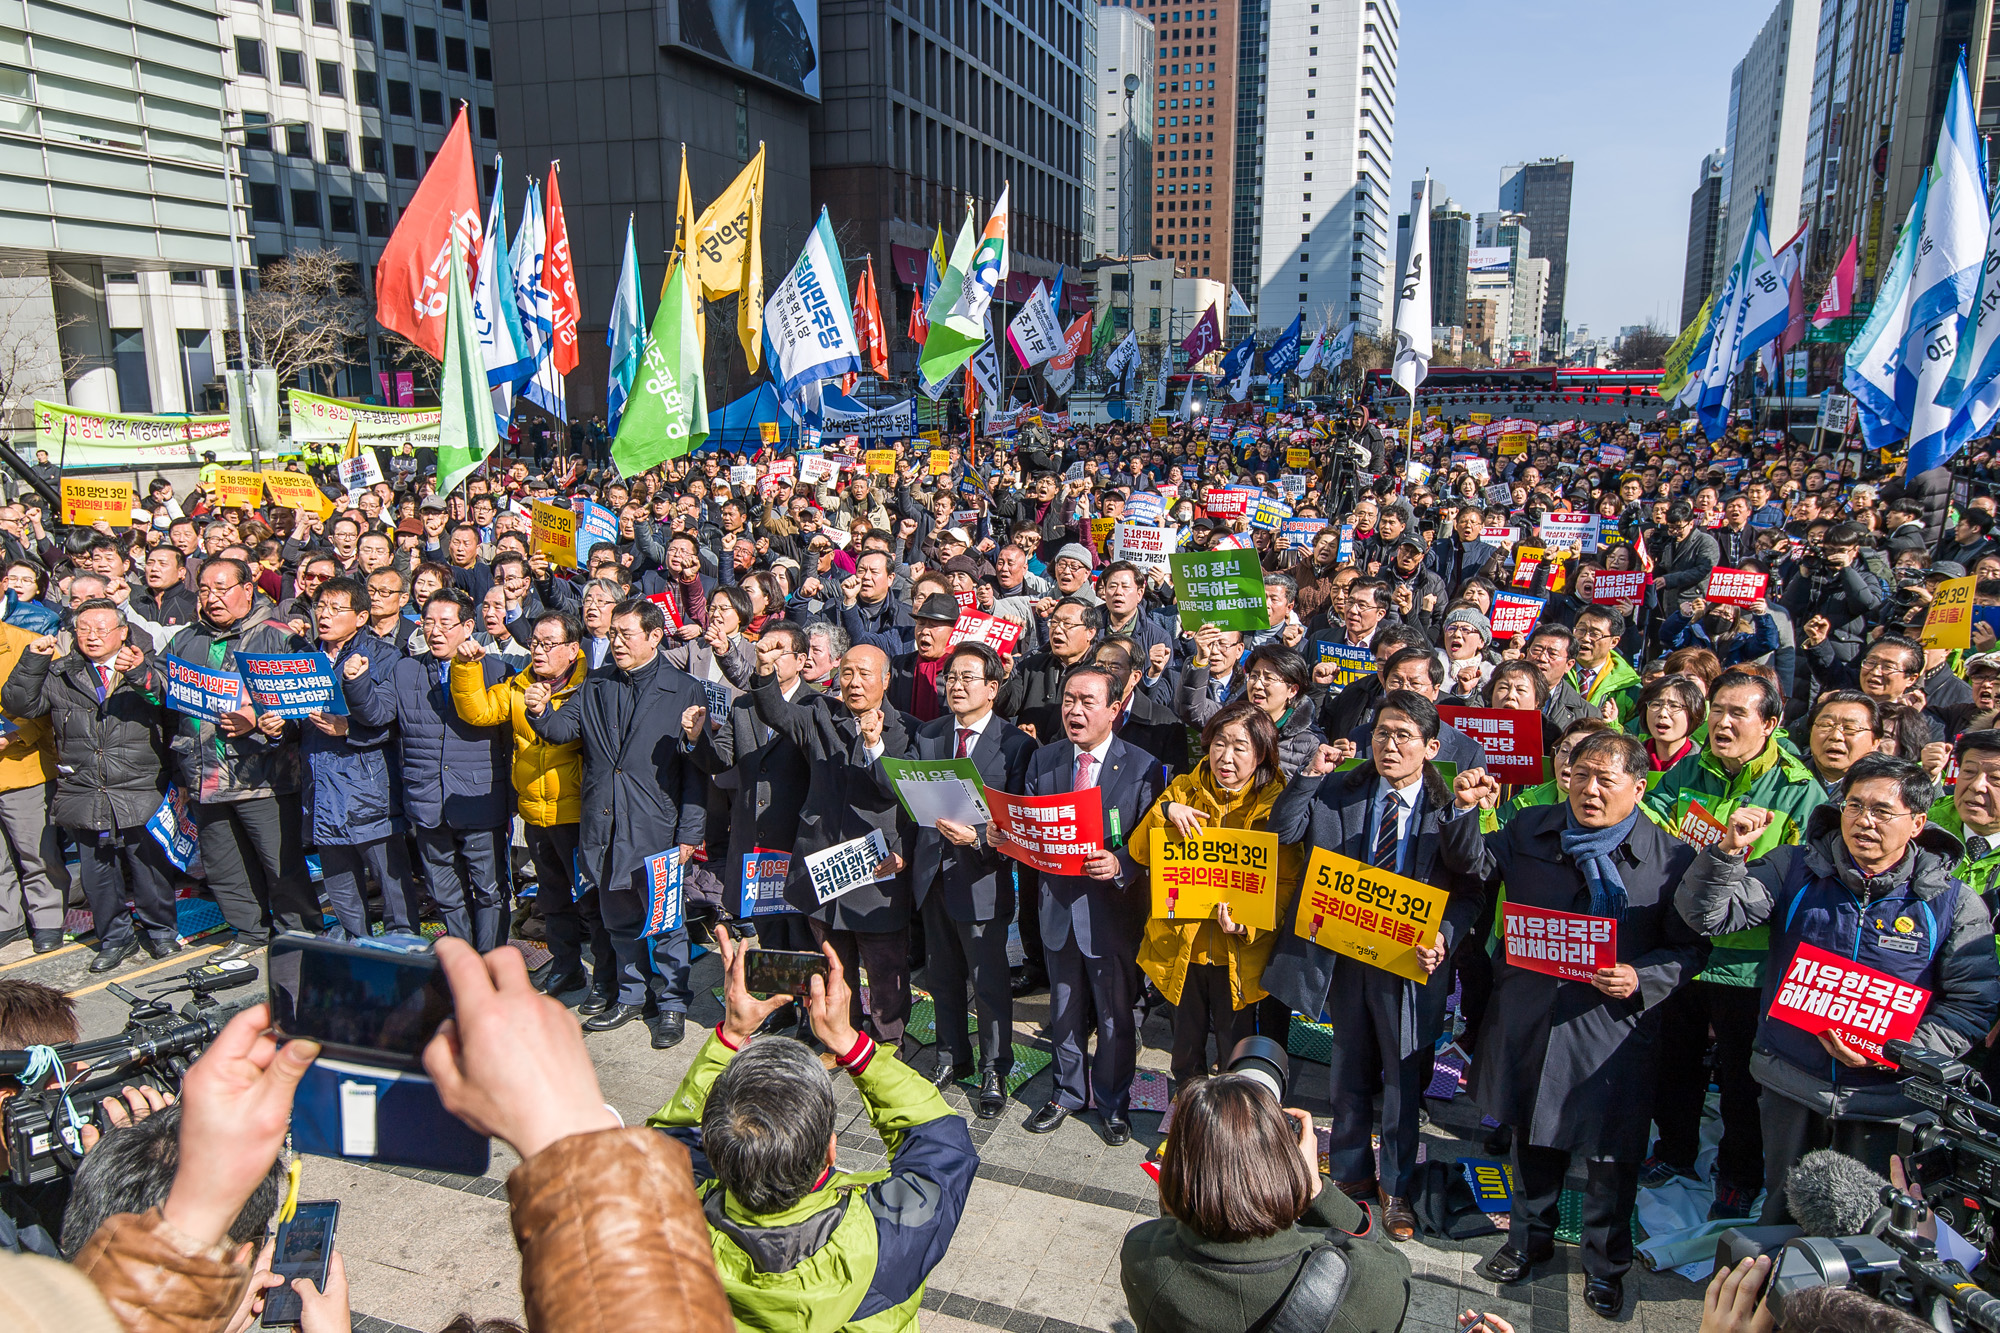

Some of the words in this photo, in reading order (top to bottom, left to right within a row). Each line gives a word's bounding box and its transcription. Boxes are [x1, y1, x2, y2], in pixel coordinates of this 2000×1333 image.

[293, 400, 324, 416] 5·18
[328, 406, 348, 421] 정신
[351, 408, 412, 426] 민주평화당이
[81, 416, 104, 439] 망언
[108, 420, 128, 438] 3적
[129, 420, 179, 442] 제명하라!
[220, 476, 236, 484] 5.18
[238, 476, 252, 486] 망언
[220, 486, 248, 494] 국회의원
[66, 486, 86, 498] 5.18
[88, 487, 108, 499] 망언
[110, 488, 127, 500] 3인
[1208, 492, 1247, 504] 자유한국당
[67, 498, 102, 510] 국회의원
[104, 500, 127, 511] 퇴출!
[542, 510, 557, 529] 망언
[557, 516, 570, 534] 3인
[1256, 511, 1282, 528] OUT!
[1122, 538, 1140, 550] 왜곡
[1141, 540, 1163, 552] 처벌!
[1144, 552, 1166, 563] 개정!
[1182, 564, 1208, 579] 5.18
[1210, 560, 1241, 577] 정신
[1595, 572, 1646, 588] 자유한국당
[1711, 573, 1766, 586] 자유한국당
[1187, 580, 1240, 598] 모독하는
[1594, 586, 1638, 599] 해체하라!
[1708, 584, 1756, 598] 해체하라!
[1949, 586, 1970, 604] 3인
[1179, 600, 1214, 612] 자유한국당
[1216, 597, 1263, 611] 해산하라!
[1494, 606, 1538, 620] 자유한국당
[1492, 618, 1531, 632] 해체하라!
[246, 659, 318, 676] 자유한국당!
[169, 662, 240, 697] 5·18역사왜곡
[169, 680, 204, 708] 처벌법
[282, 688, 335, 704] 반납하라!
[1454, 716, 1514, 736] 탄핵폐족
[1007, 804, 1076, 822] 탄핵폐족
[1010, 820, 1078, 841] 보수잔당
[1042, 842, 1097, 856] 제명하라!
[1163, 841, 1198, 861] 5.18
[1202, 842, 1238, 865] 망언
[1241, 844, 1268, 870] 3인
[810, 845, 854, 876] 5.18모독
[814, 842, 880, 886] 역사왜곡
[1162, 866, 1228, 889] 국회의원
[1230, 870, 1266, 894] 퇴출!
[1316, 864, 1355, 896] 5.18
[1355, 877, 1398, 912] 망언
[1395, 893, 1432, 925] 3인
[752, 905, 784, 914] 더불어민주당
[1311, 890, 1380, 934] 국회의원
[1378, 916, 1424, 949] 퇴출!
[1505, 914, 1612, 944] 자유한국당
[1355, 944, 1378, 961] 정의당
[1507, 936, 1596, 965] 해체하라!
[1788, 957, 1924, 1015] 자유한국당
[1778, 982, 1894, 1036] 해체하라!
[1474, 1166, 1508, 1199] OUT!
